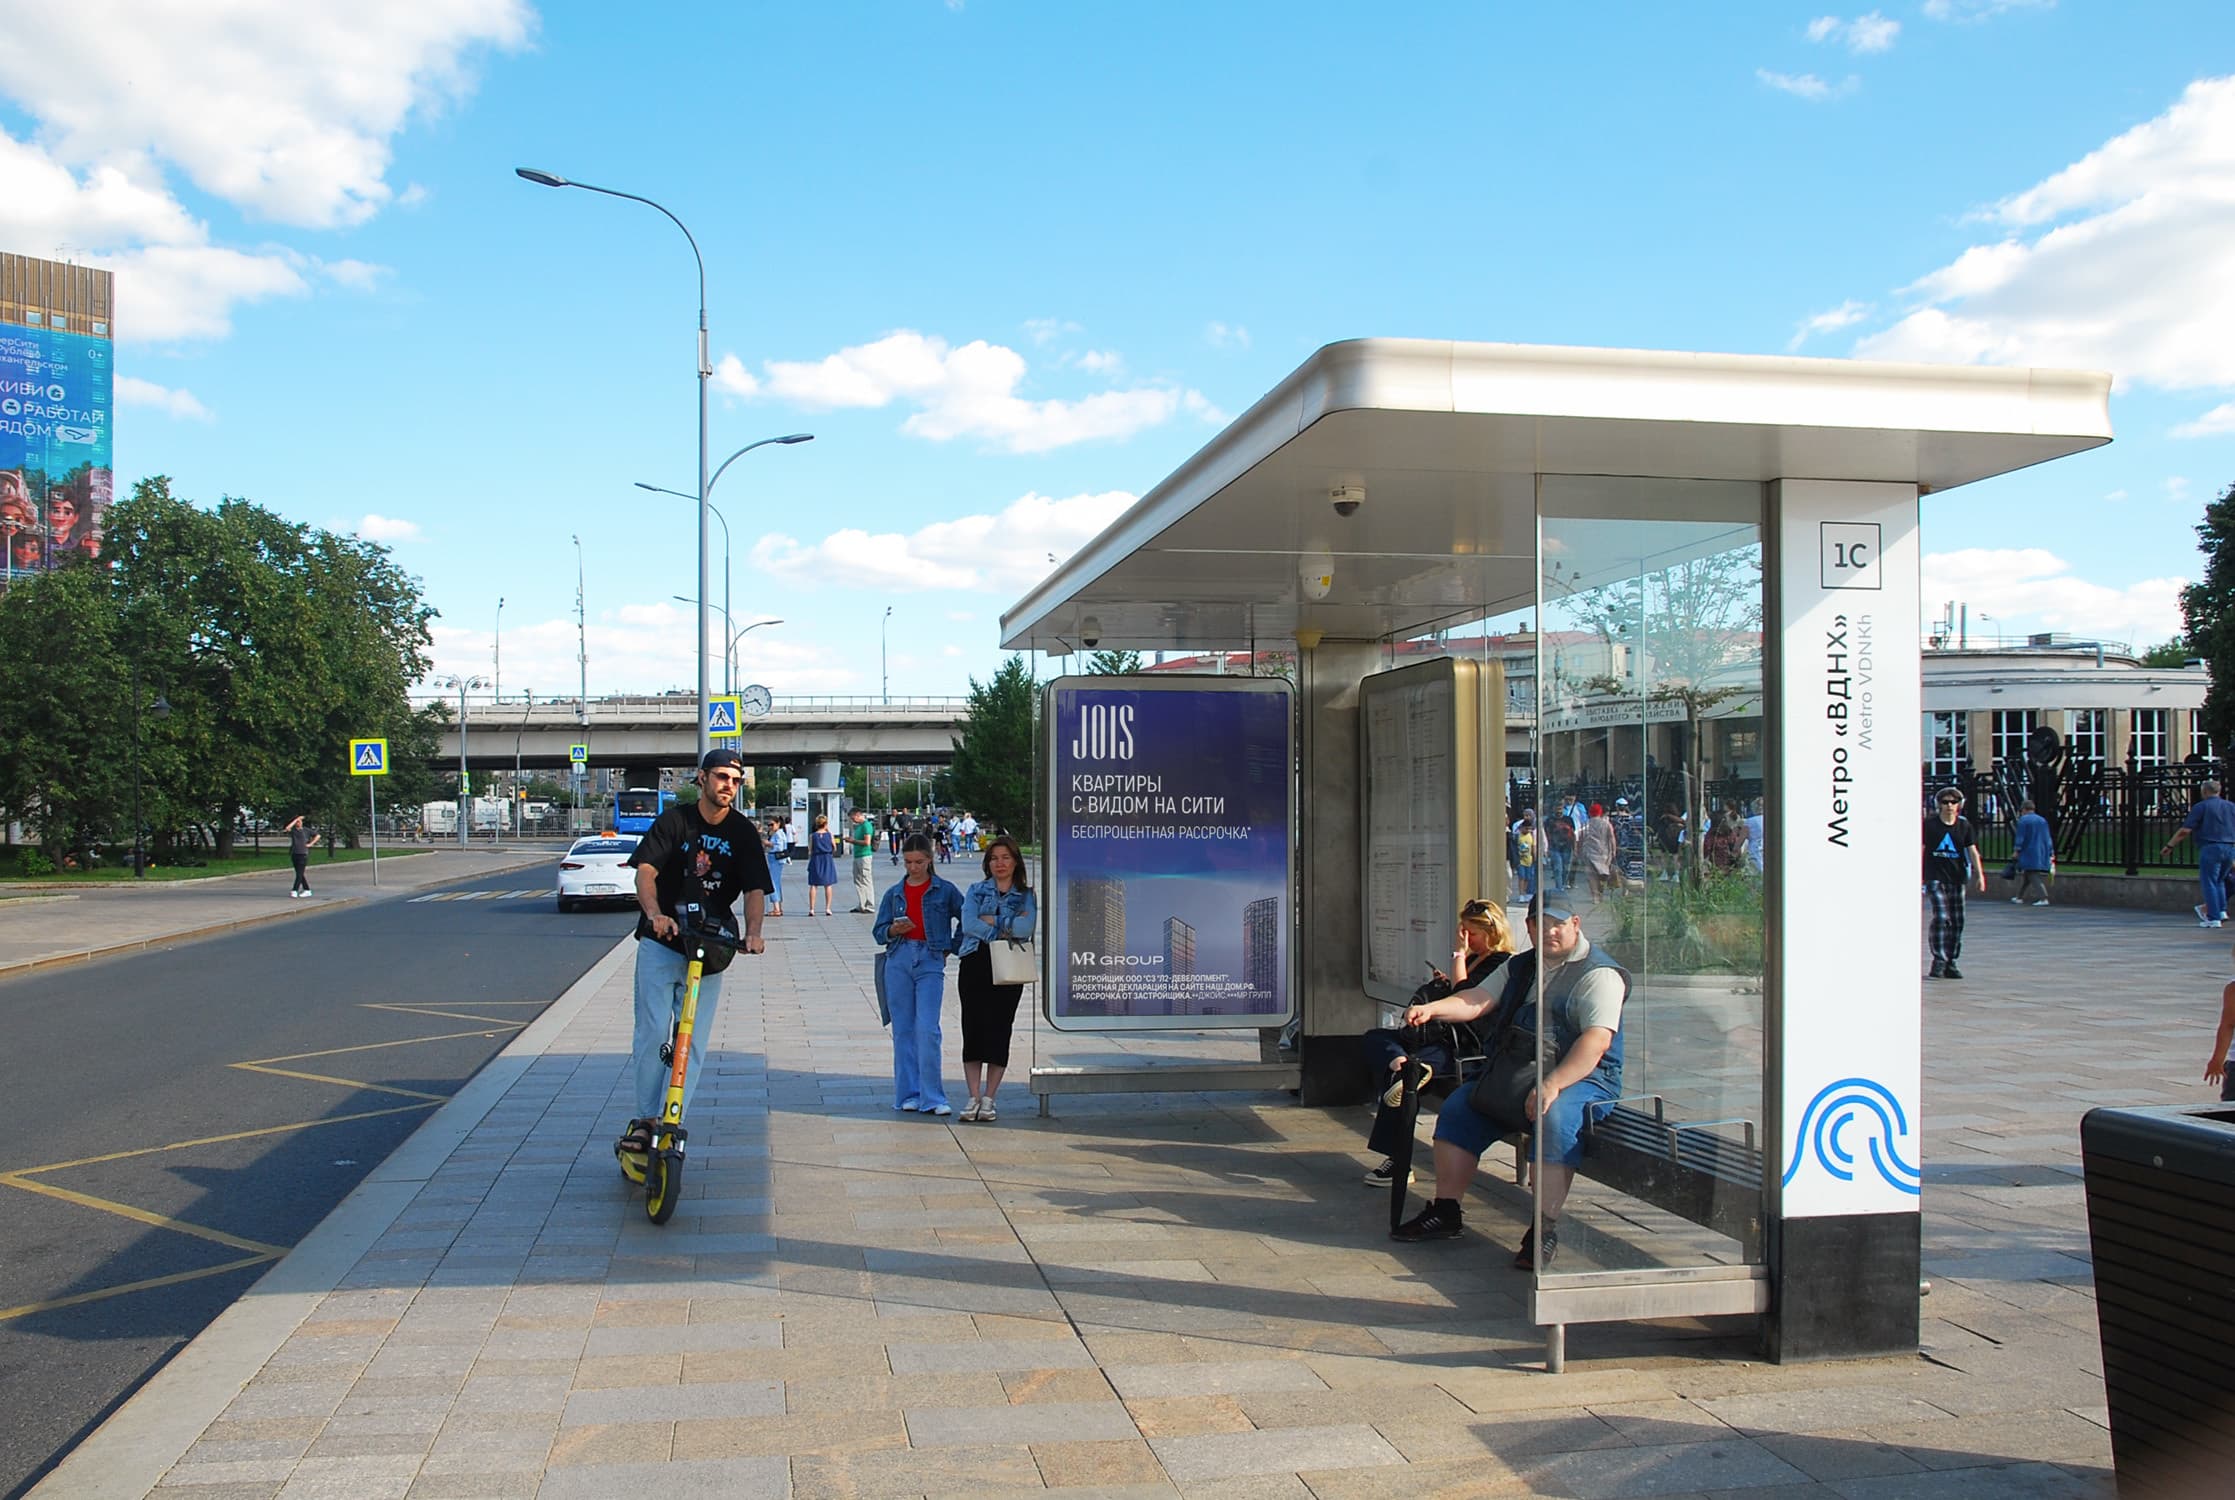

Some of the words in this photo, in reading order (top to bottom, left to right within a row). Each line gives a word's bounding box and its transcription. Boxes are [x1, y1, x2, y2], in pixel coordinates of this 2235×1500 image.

[0, 337, 39, 350] ерСити
[88, 349, 103, 360] 0+
[24, 402, 104, 424] РАБОТАЙ
[1857, 614, 1873, 686] VDNKh
[1827, 614, 1853, 737] «ВДНХ»
[1858, 692, 1873, 750] Metro
[1072, 704, 1134, 760] JOIS
[1072, 775, 1161, 793] КВАРТИРЫ
[1072, 796, 1082, 814] С
[1088, 796, 1148, 816] ВИДОМ
[1155, 797, 1176, 813] НА
[1181, 797, 1224, 814] СИТИ
[1828, 747, 1853, 848] Метро
[1072, 825, 1174, 840] БЕСПРОЦЕНТНАЯ
[1072, 951, 1096, 966] MR
[1100, 955, 1164, 966] GROUP
[1072, 974, 1124, 983] ЗАСТРОЙЩИК
[1125, 974, 1142, 982] ООО
[1072, 983, 1117, 992] ПРОЕКТНАЯ
[1118, 983, 1167, 992] ДЕКЛАРАЦИЯ
[1168, 983, 1179, 991] НА
[1180, 981, 1205, 991] САЙТЕ
[1122, 992, 1132, 1000] ОТ
